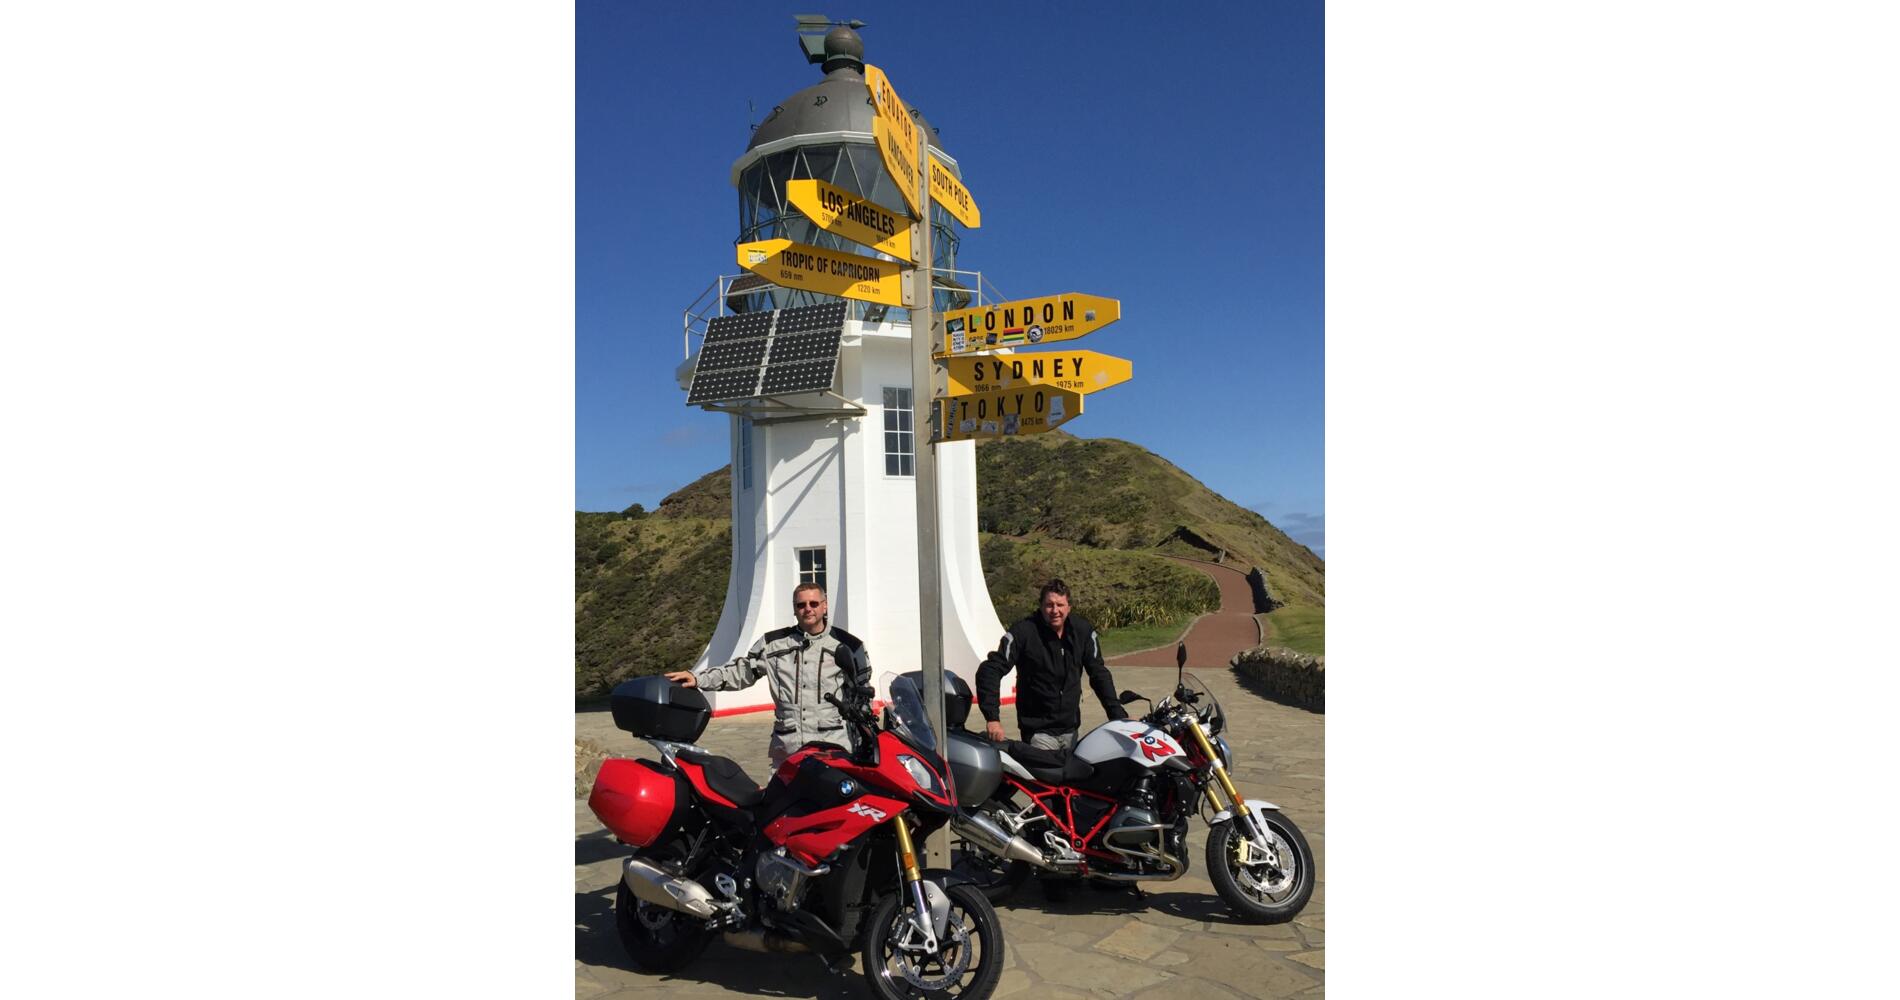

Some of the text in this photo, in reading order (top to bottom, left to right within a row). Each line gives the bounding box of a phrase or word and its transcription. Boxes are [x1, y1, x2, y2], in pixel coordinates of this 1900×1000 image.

[881, 80, 912, 144] EQUATOR
[887, 128, 914, 188] VANCOUVER
[932, 164, 953, 198] SOUTH
[954, 181, 969, 212] POLE
[821, 187, 895, 236] LOS ANGELES
[780, 250, 813, 271] TROPIC
[817, 256, 829, 272] OF
[831, 259, 880, 283] CAPRICORN
[857, 284, 880, 295] 1220 km
[969, 300, 1074, 332] LONDON
[1044, 324, 1075, 335] 18029 km
[974, 357, 1083, 381] SYDNEY
[1073, 380, 1084, 388] km
[961, 391, 1044, 420] TOKYO
[847, 803, 887, 822] XR
